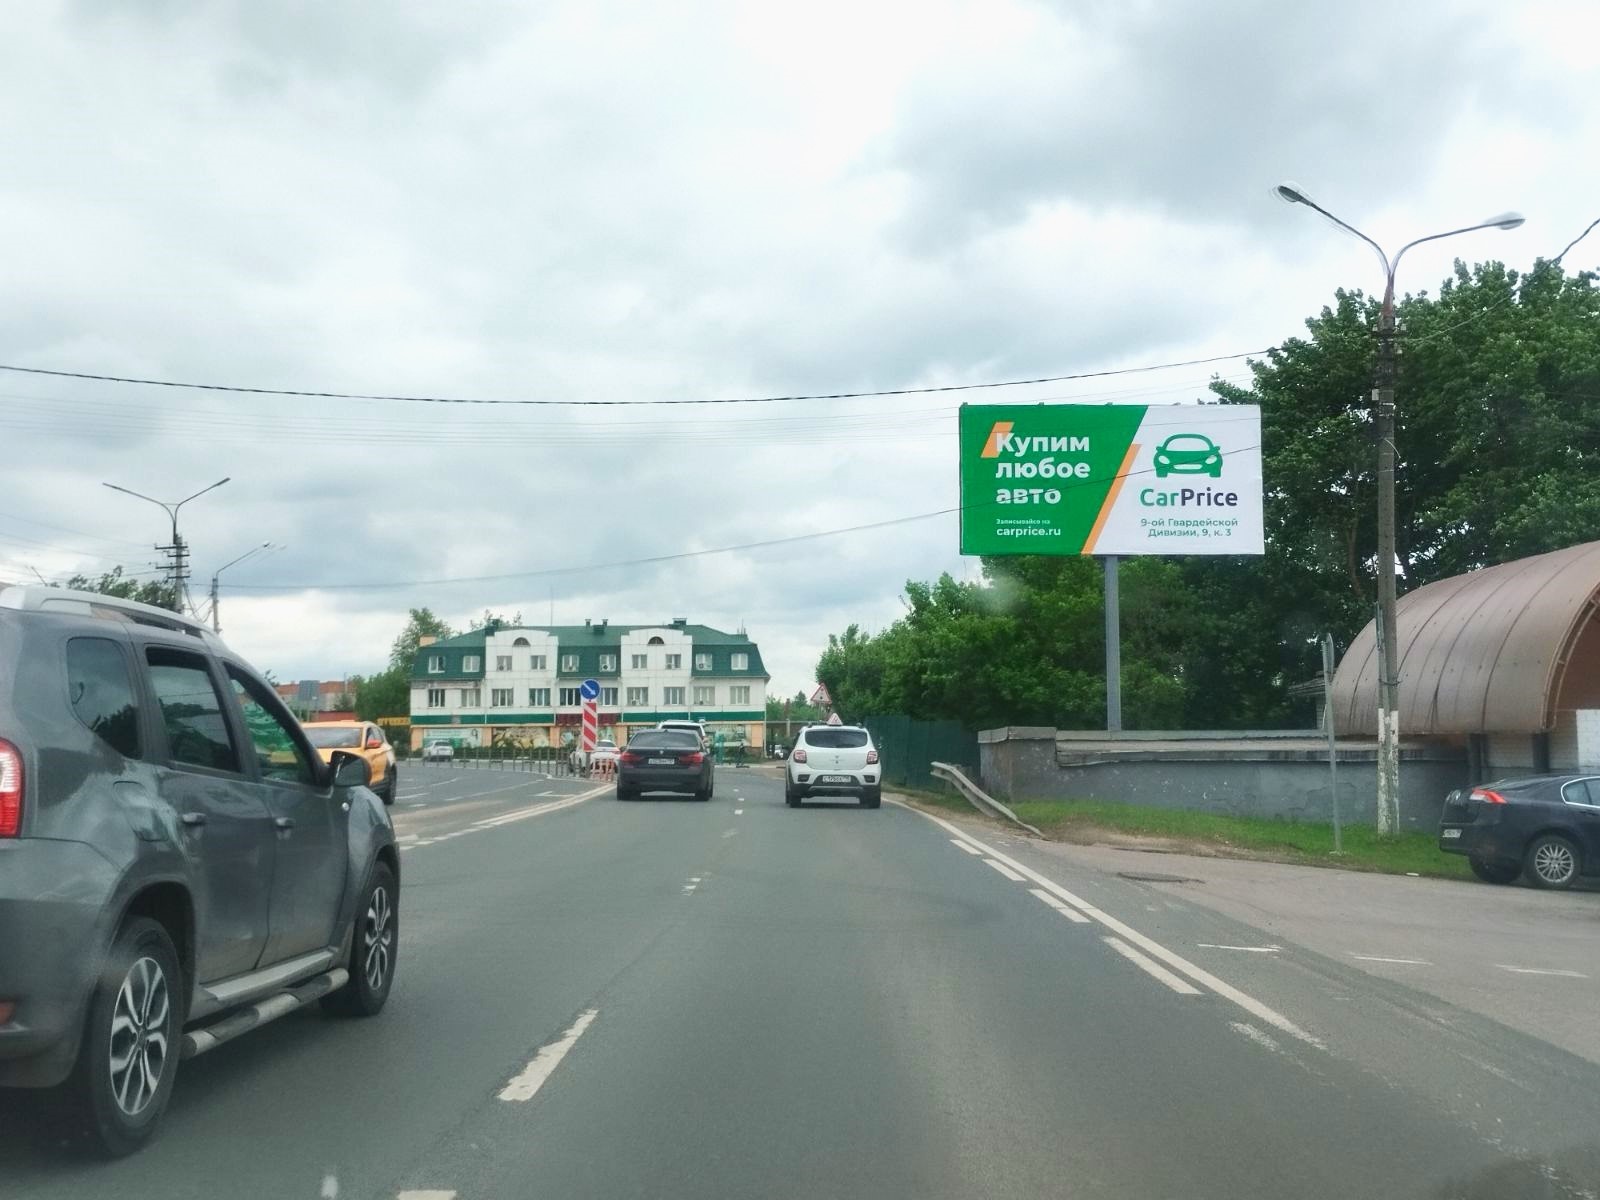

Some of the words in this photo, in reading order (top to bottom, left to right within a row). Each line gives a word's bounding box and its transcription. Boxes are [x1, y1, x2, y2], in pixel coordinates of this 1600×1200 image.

[996, 432, 1090, 457] Купим
[995, 457, 1091, 478] любое
[996, 488, 1062, 505] авто
[1140, 486, 1238, 507] CarPrice
[1140, 518, 1165, 527] 9-ой
[1168, 518, 1238, 528] Гвардейской
[996, 526, 1062, 538] carprice.ru
[1148, 528, 1200, 538] Дивизии,
[1225, 528, 1232, 537] 3
